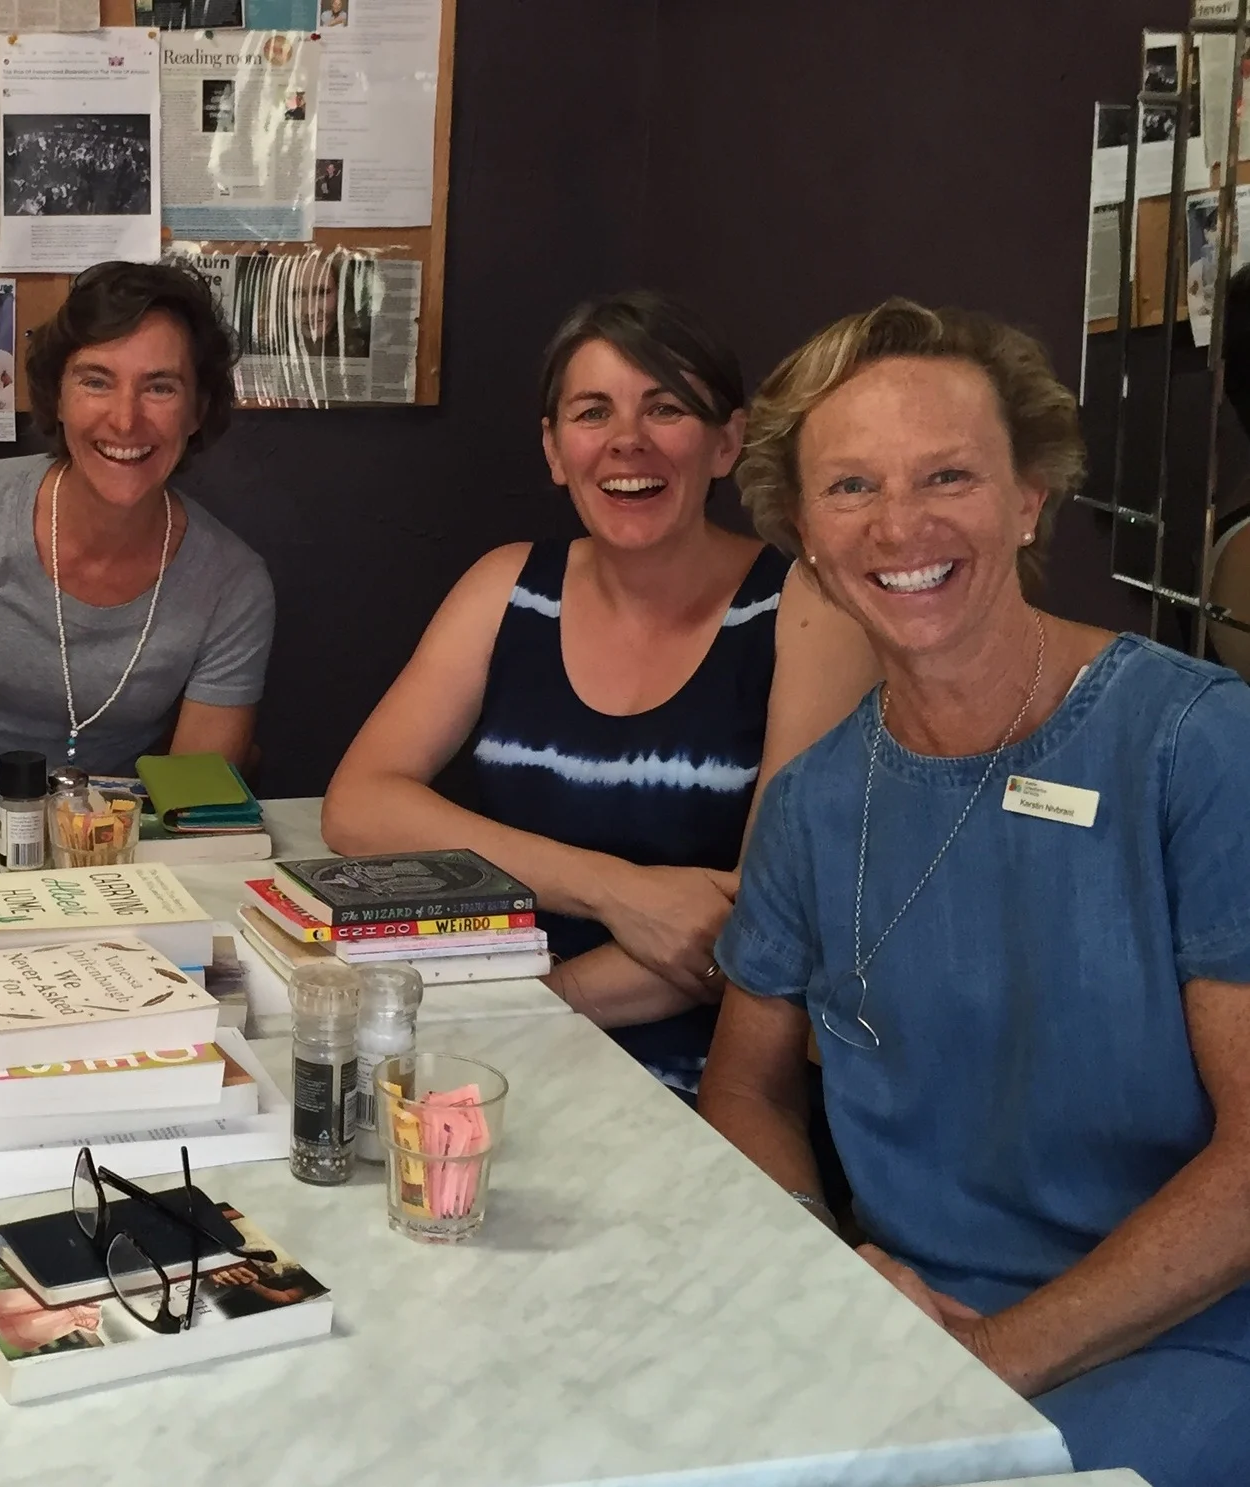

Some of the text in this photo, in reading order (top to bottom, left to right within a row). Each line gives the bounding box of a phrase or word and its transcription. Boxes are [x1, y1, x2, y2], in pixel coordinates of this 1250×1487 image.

[164, 49, 223, 68] Reading
[0, 888, 46, 914] HOME
[41, 877, 99, 916] Albert
[89, 873, 149, 916] CARRYING
[341, 911, 359, 923] The
[362, 908, 412, 920] WIZARD
[427, 905, 443, 915] OZ
[9, 952, 85, 1015] Never Asked
[54, 969, 81, 989] We
[105, 955, 143, 989] Vanessa
